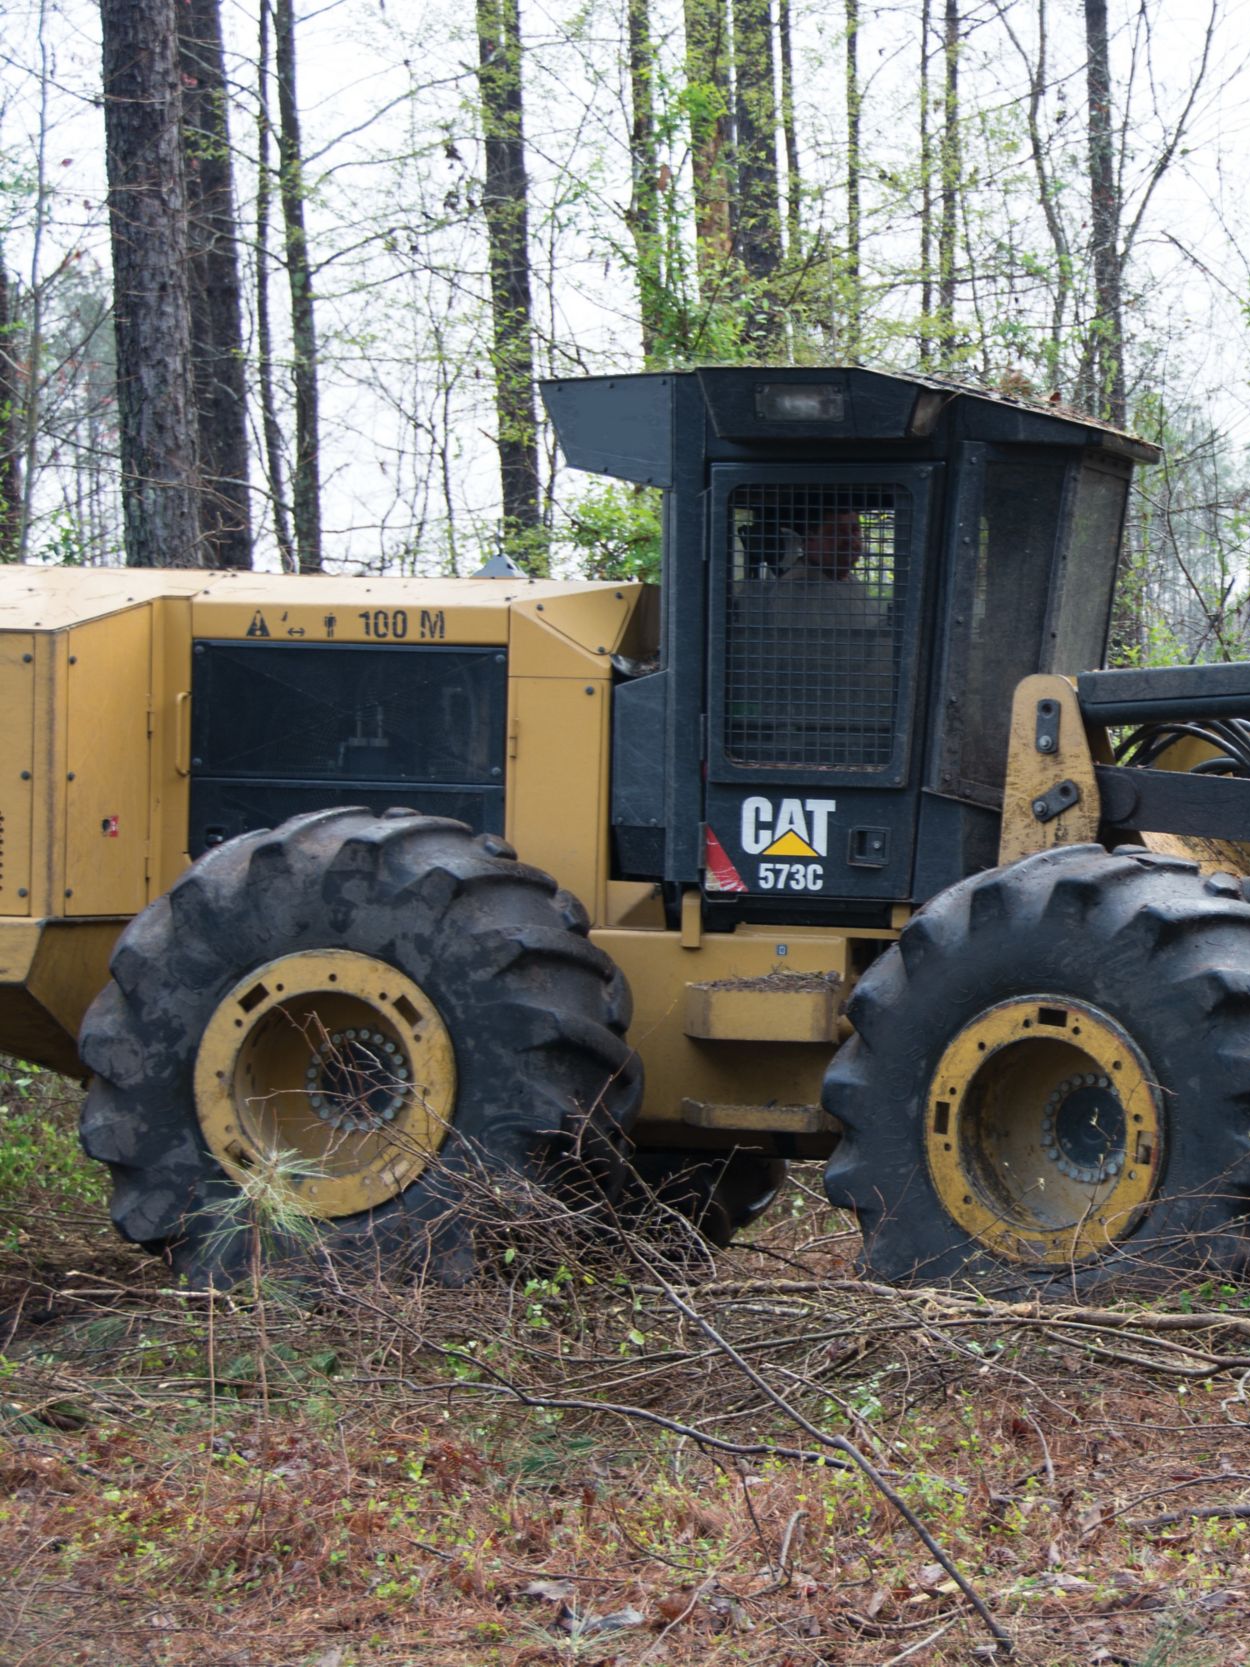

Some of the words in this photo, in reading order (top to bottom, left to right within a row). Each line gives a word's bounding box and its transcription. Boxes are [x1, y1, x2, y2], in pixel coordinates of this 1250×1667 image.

[358, 609, 408, 639] 100
[420, 609, 445, 639] M
[741, 796, 836, 857] CAT
[758, 863, 824, 890] 573C
